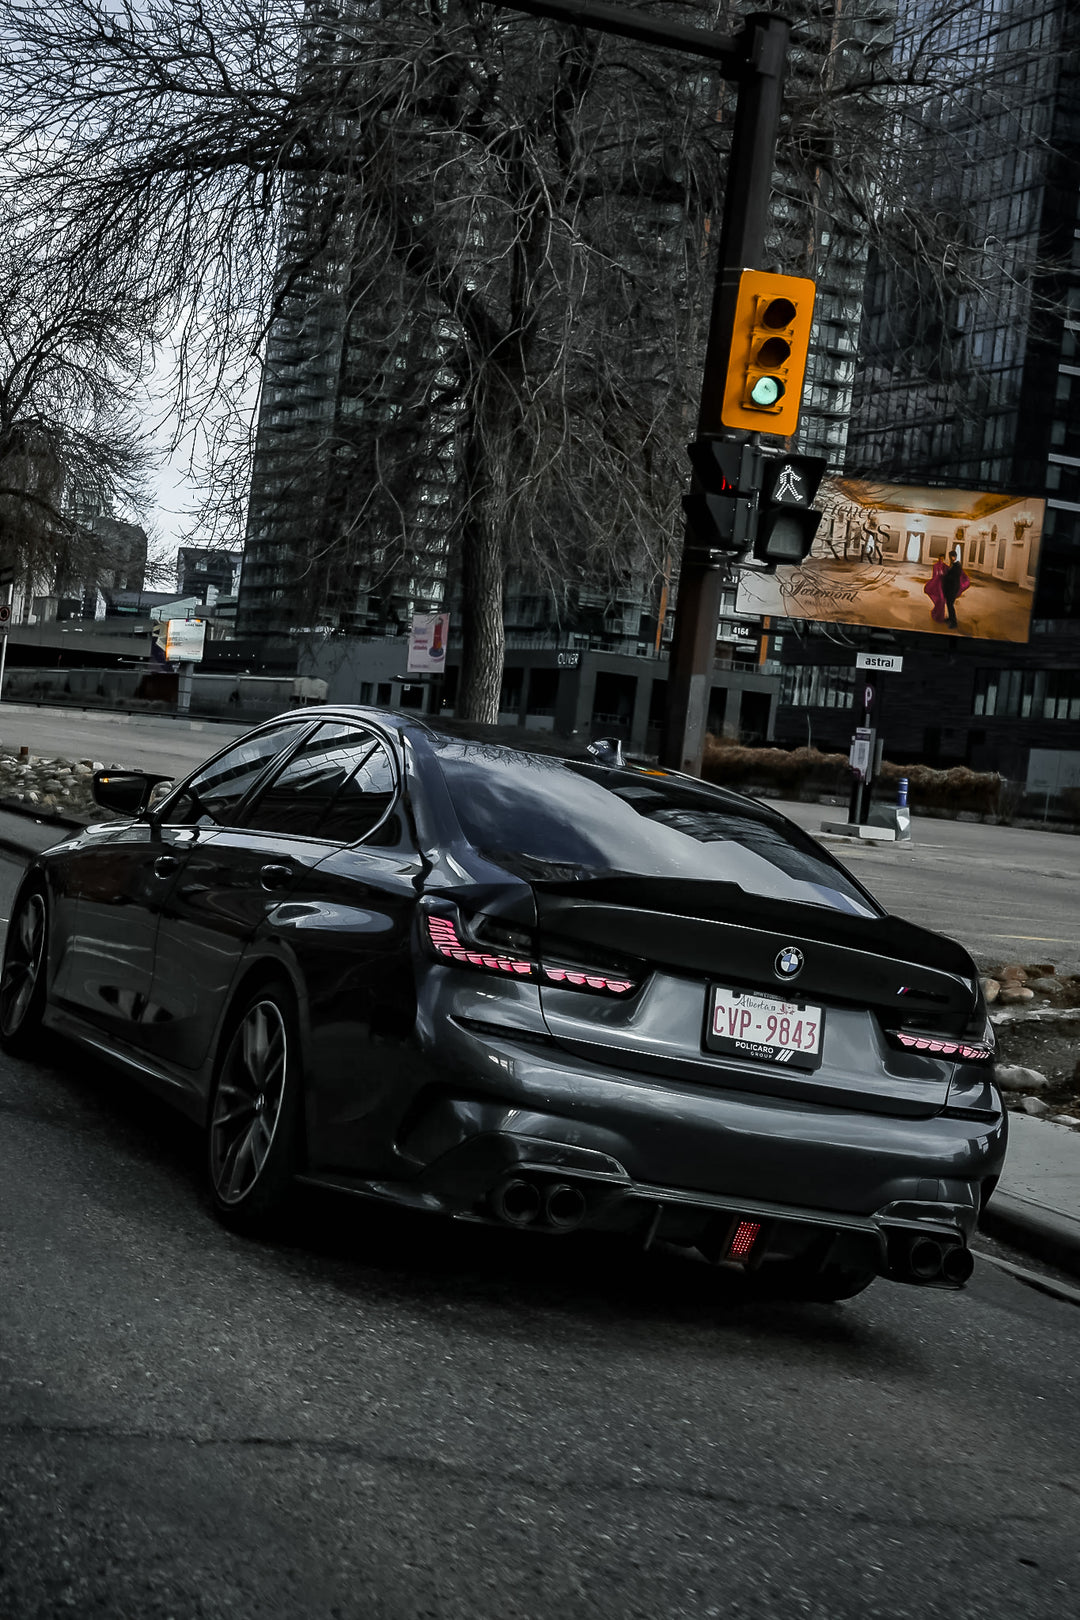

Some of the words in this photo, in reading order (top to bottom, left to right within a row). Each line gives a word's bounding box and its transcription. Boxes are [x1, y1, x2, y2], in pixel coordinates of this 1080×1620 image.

[865, 657, 894, 668] astral
[734, 994, 772, 1011] Alberta
[713, 1005, 817, 1050] CVP-9843
[735, 1041, 774, 1054] POLICARO
[750, 1051, 773, 1059] GROUP
